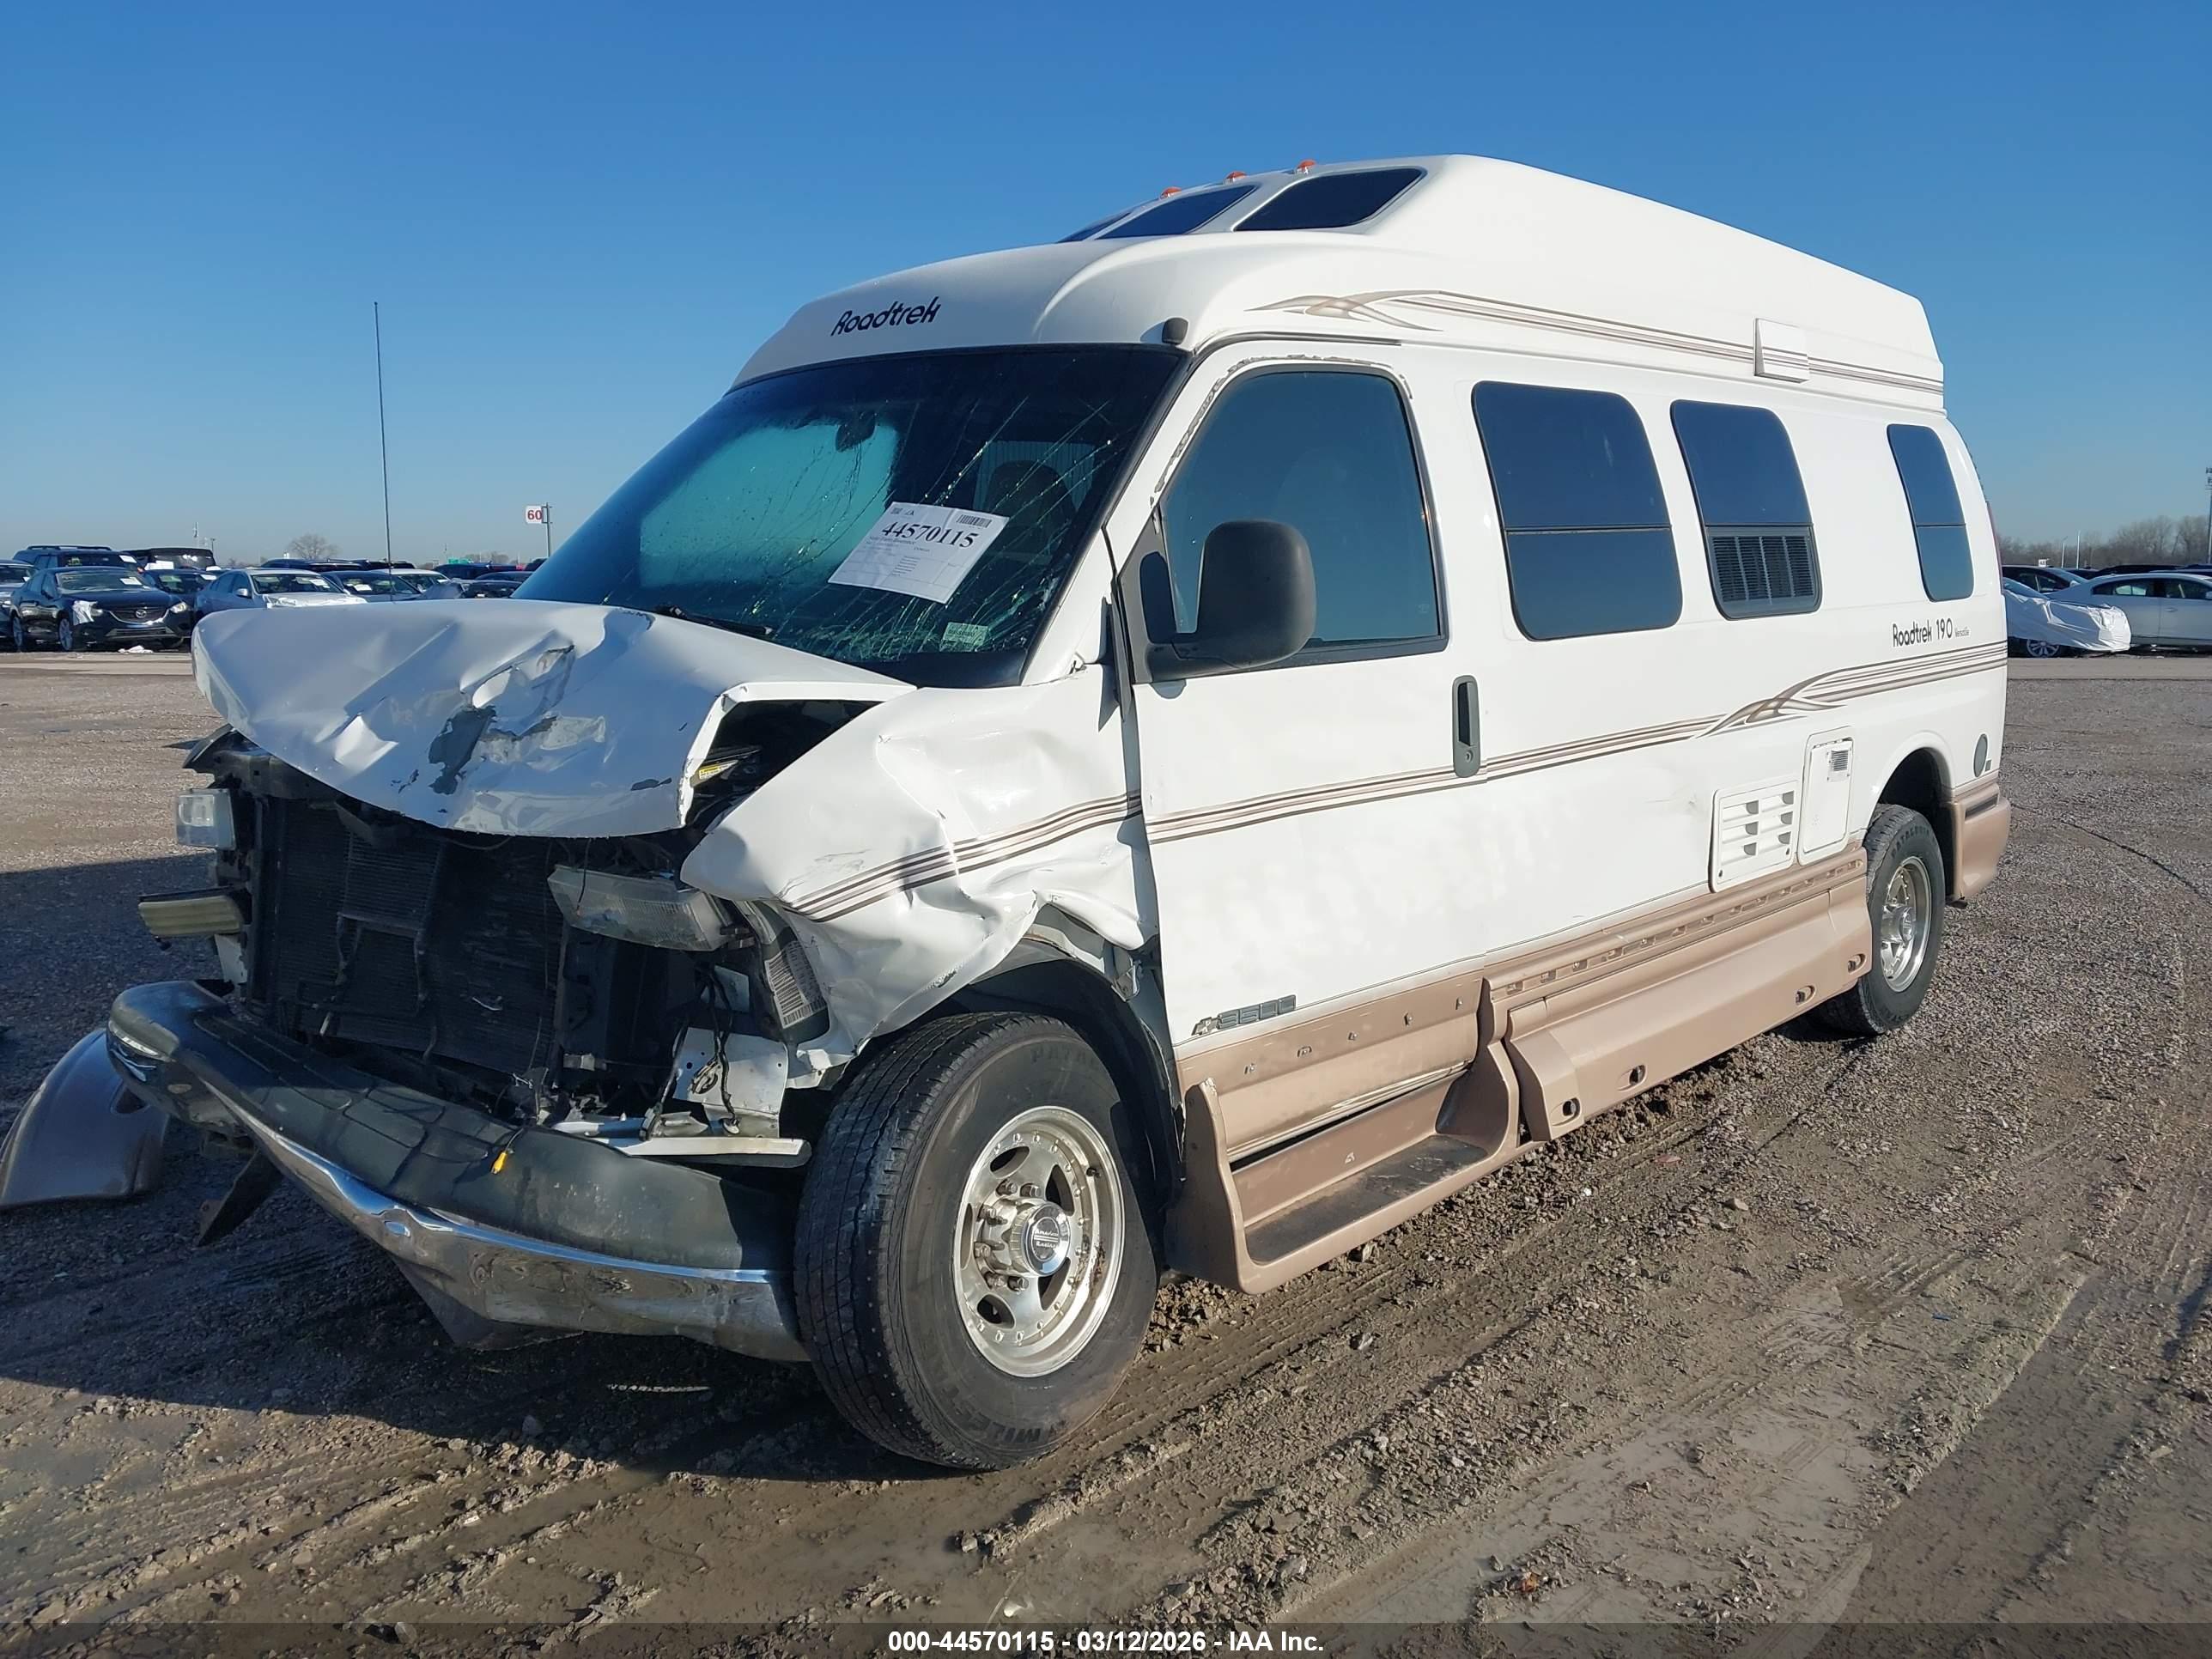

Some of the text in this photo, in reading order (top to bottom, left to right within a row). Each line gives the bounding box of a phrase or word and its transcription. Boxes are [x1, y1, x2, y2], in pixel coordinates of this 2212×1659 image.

[830, 295, 942, 337] Roadtrek
[527, 509, 543, 520] 60
[881, 520, 981, 549] 44570115
[1892, 619, 1932, 647] Roadtrek
[1936, 617, 1953, 640] 190
